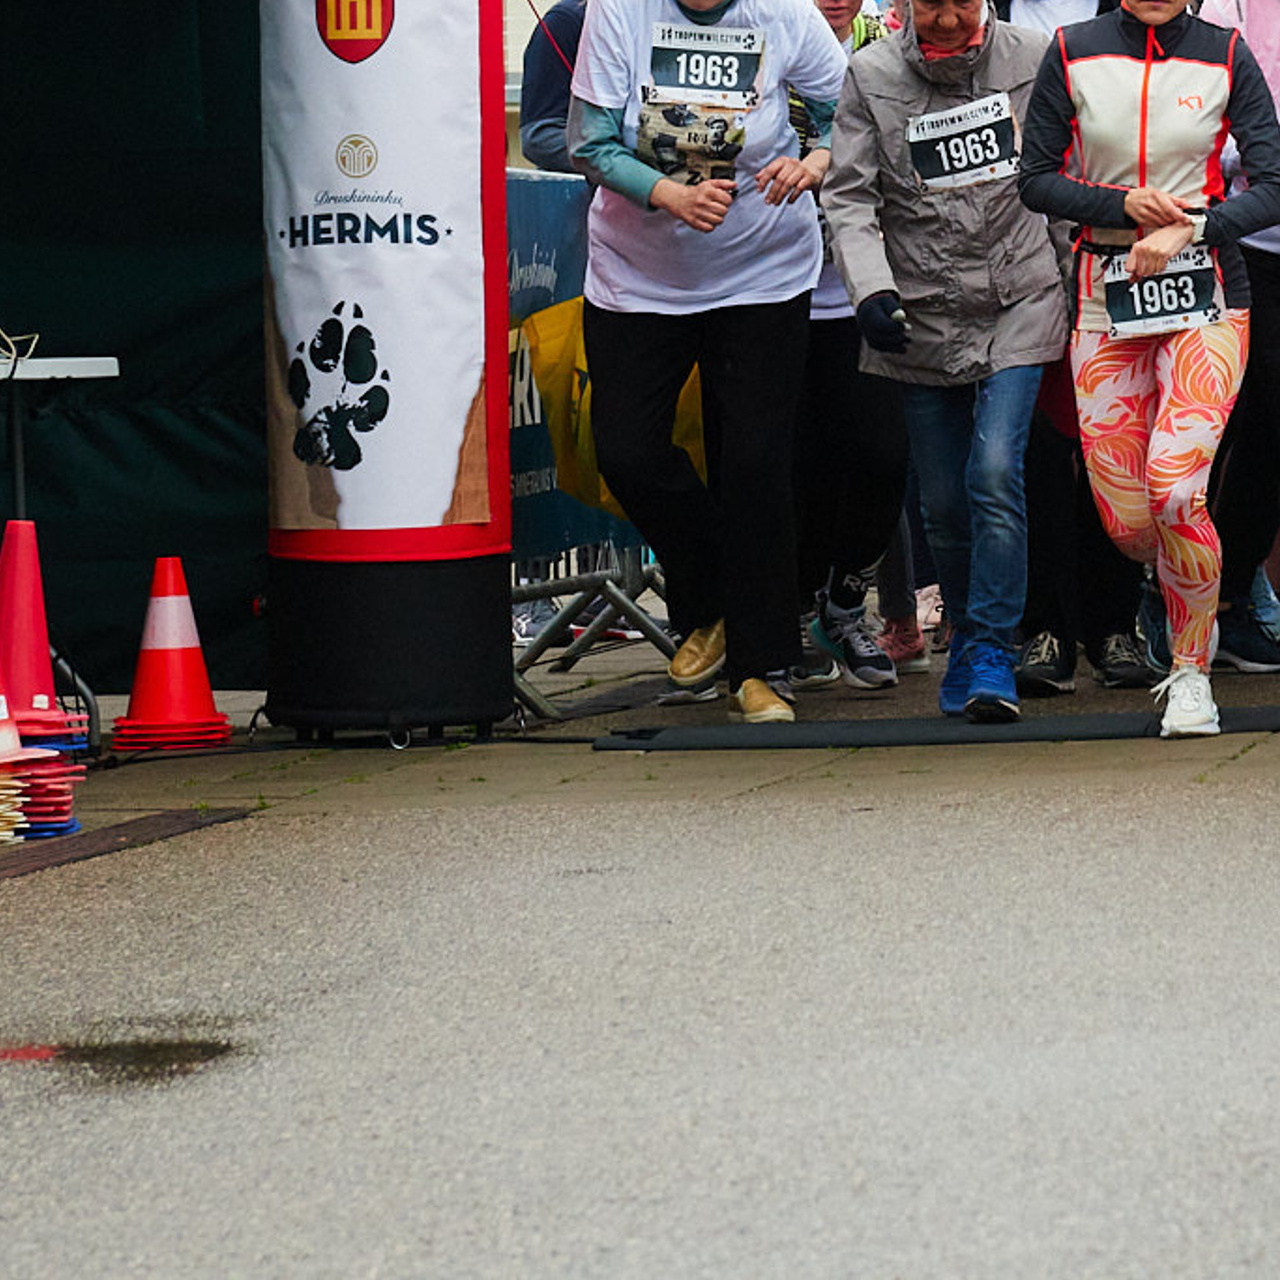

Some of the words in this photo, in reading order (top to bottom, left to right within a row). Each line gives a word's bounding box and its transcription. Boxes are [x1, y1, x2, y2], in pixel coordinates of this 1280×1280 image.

[676, 53, 740, 88] 1963
[935, 128, 1000, 172] 1963
[289, 213, 440, 248] HERMIS
[1128, 274, 1197, 317] 1963
